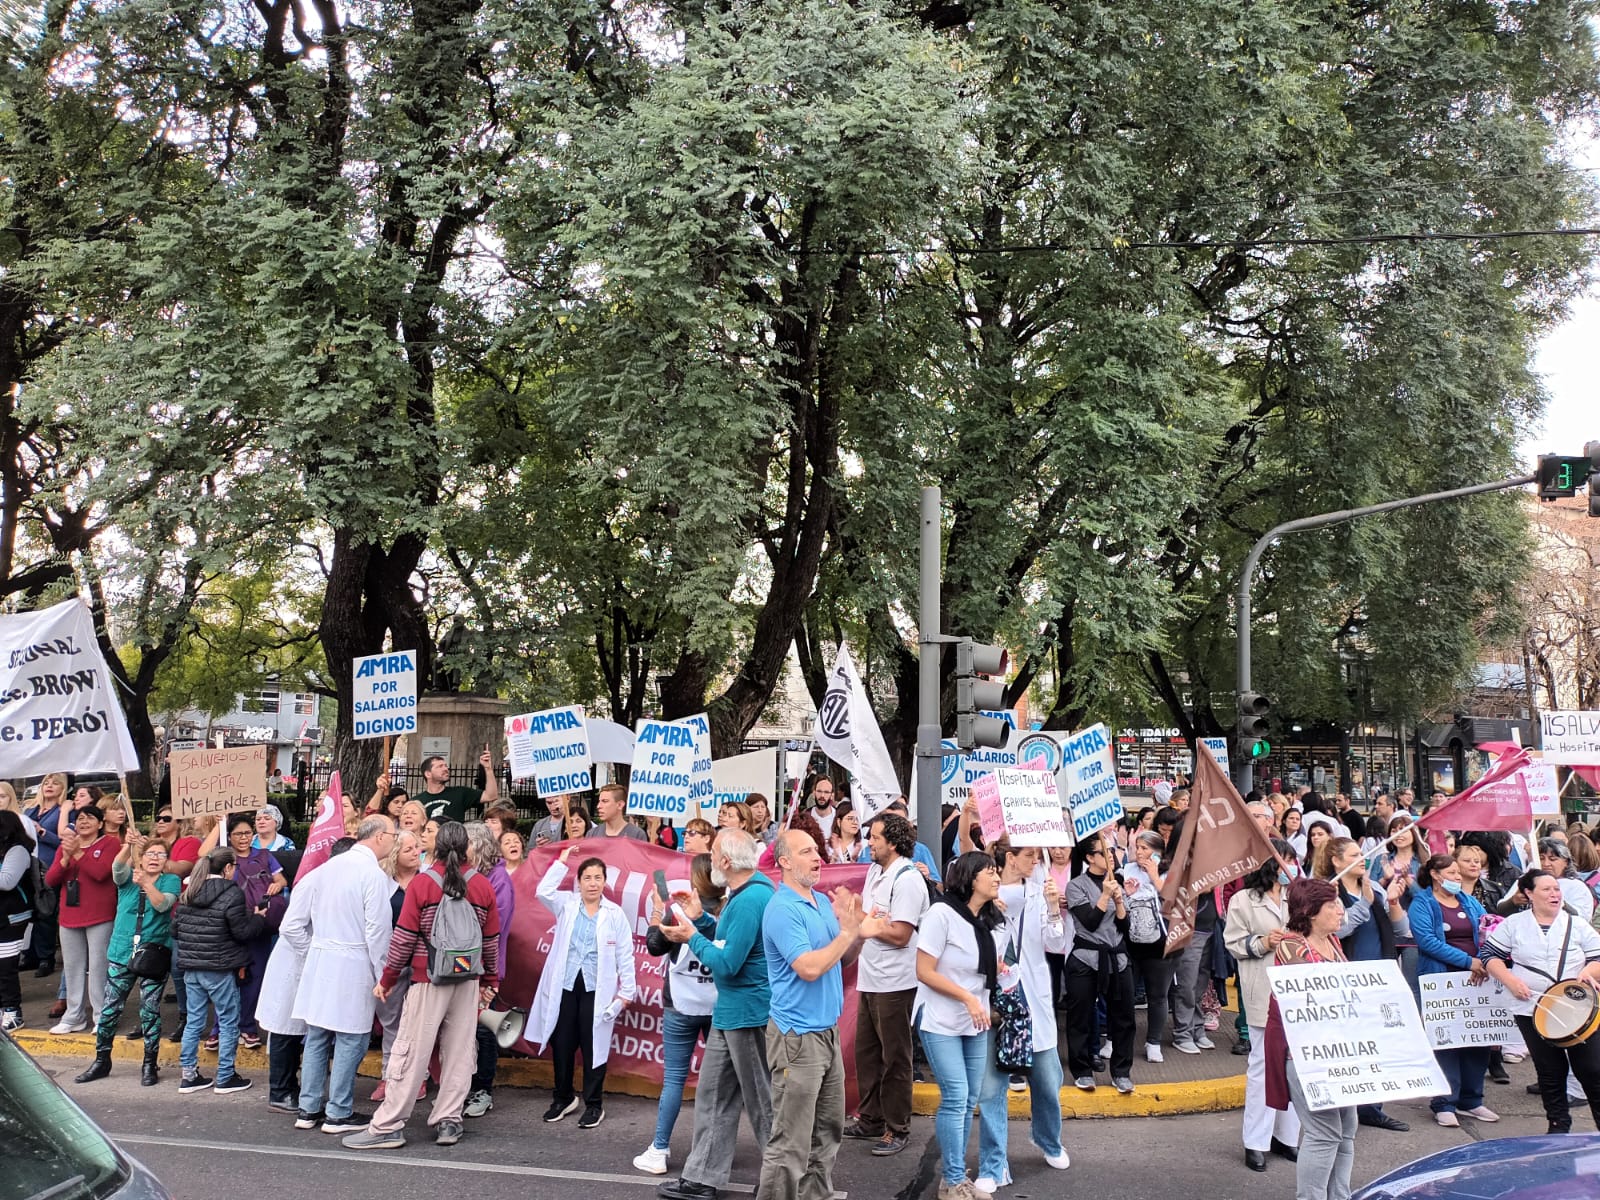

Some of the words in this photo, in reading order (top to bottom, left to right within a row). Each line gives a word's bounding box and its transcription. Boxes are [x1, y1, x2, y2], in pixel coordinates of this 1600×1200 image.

[1557, 463, 1569, 489] 3
[356, 655, 414, 678] AMRA
[373, 681, 397, 694] POR
[355, 696, 415, 713] SALARIOS
[355, 716, 415, 735] DIGNOS
[530, 710, 583, 734] AMRA
[638, 723, 694, 747] AMRA
[533, 743, 586, 762] SINDICATO
[965, 751, 1016, 765] SALARIOS
[1063, 729, 1106, 768] AMRA
[651, 752, 675, 766] POR
[631, 769, 690, 787] SALARIOS
[1079, 760, 1103, 780] POR
[538, 771, 590, 794] MEDICO
[1069, 774, 1115, 810] SALARIOS
[629, 792, 686, 813] DIGNOS
[1074, 798, 1121, 836] DIGNOS
[1275, 975, 1340, 994] SALARIO
[1340, 973, 1388, 988] IGUAL
[1423, 982, 1437, 991] NO
[1447, 981, 1454, 989] A
[1306, 993, 1318, 1006] A
[1341, 989, 1362, 1003] LA
[1426, 997, 1470, 1009] POLITICAS
[1478, 996, 1490, 1005] DE
[1285, 1004, 1359, 1023] CANASTA
[1425, 1011, 1456, 1022] AJUSTE
[1463, 1010, 1475, 1018] DE
[1490, 1009, 1508, 1018] LOS
[1461, 1034, 1467, 1043] Y
[1470, 1034, 1481, 1042] EL
[1483, 1033, 1508, 1042] FMI!!
[1301, 1040, 1380, 1061] FAMILIAR
[1328, 1066, 1360, 1078] ABAJO
[1370, 1064, 1382, 1073] EL
[1341, 1082, 1376, 1095] AJUSTE
[1381, 1081, 1400, 1091] DEL
[1406, 1076, 1433, 1089] FMI!!
